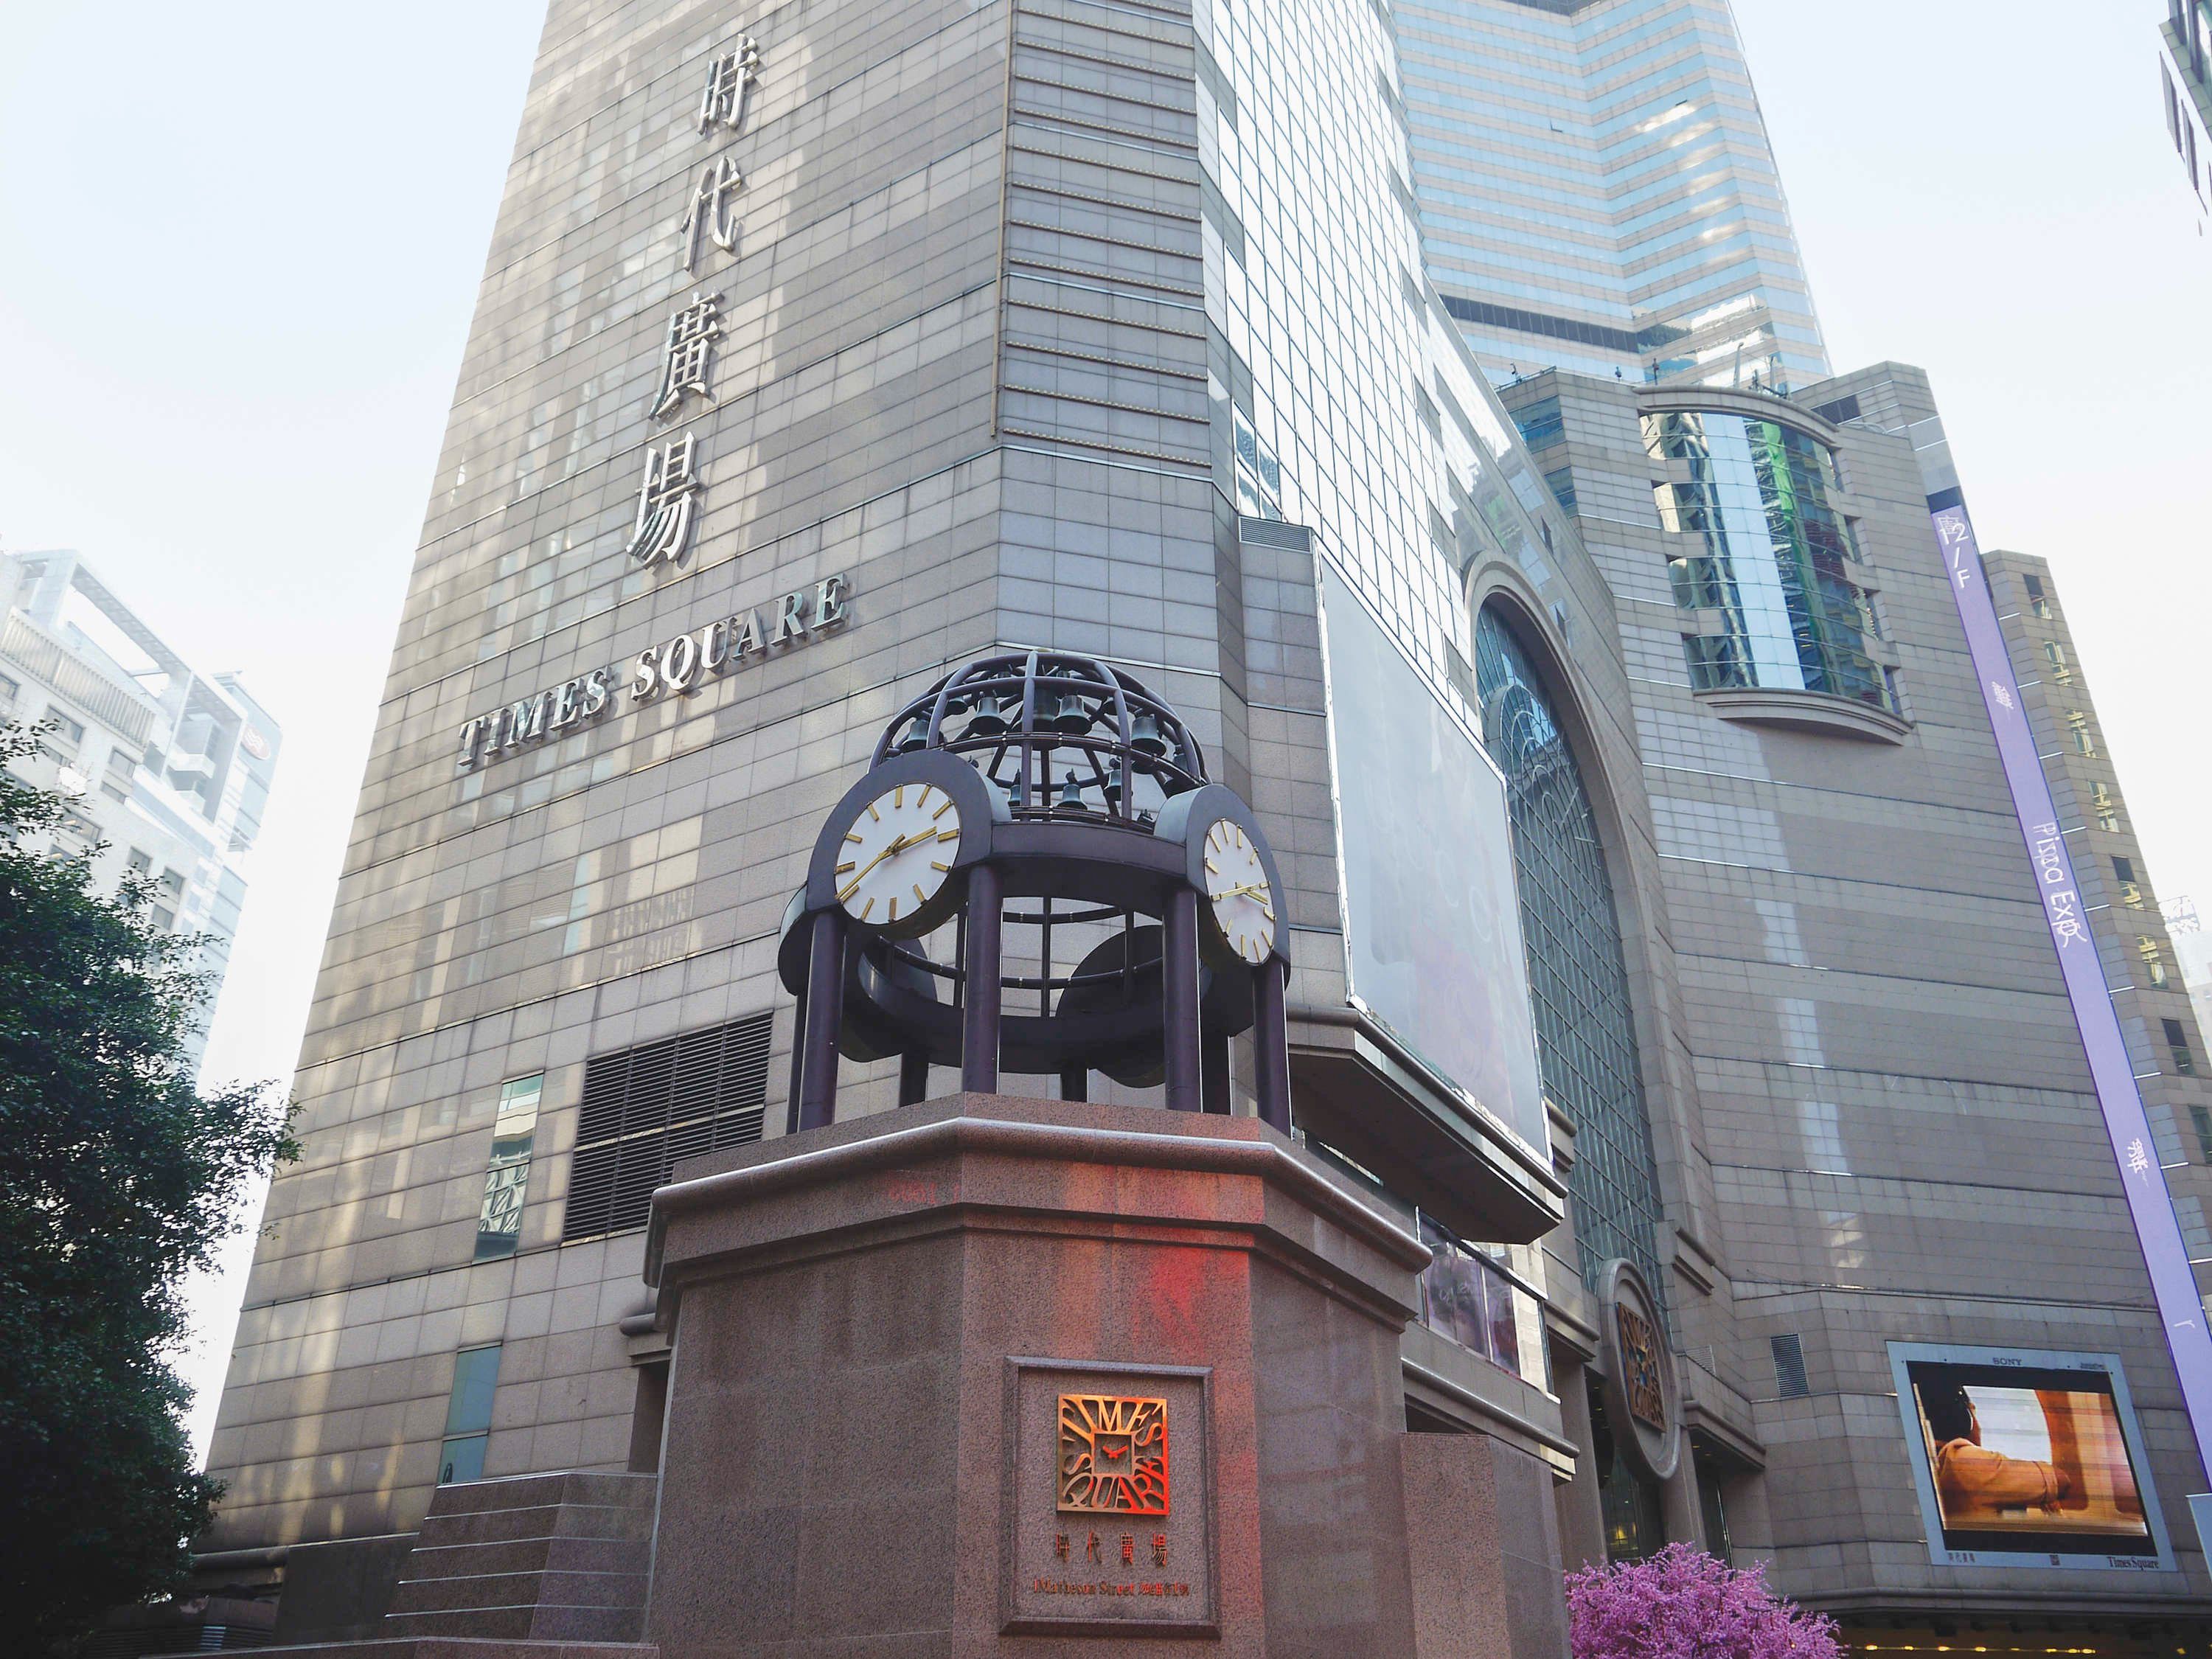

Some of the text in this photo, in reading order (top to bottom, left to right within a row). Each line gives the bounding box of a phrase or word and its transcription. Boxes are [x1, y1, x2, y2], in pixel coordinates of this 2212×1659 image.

[627, 33, 759, 569] 時代廣場
[458, 573, 847, 767] TIMES SQUARE
[1992, 1357, 2023, 1366] SONY
